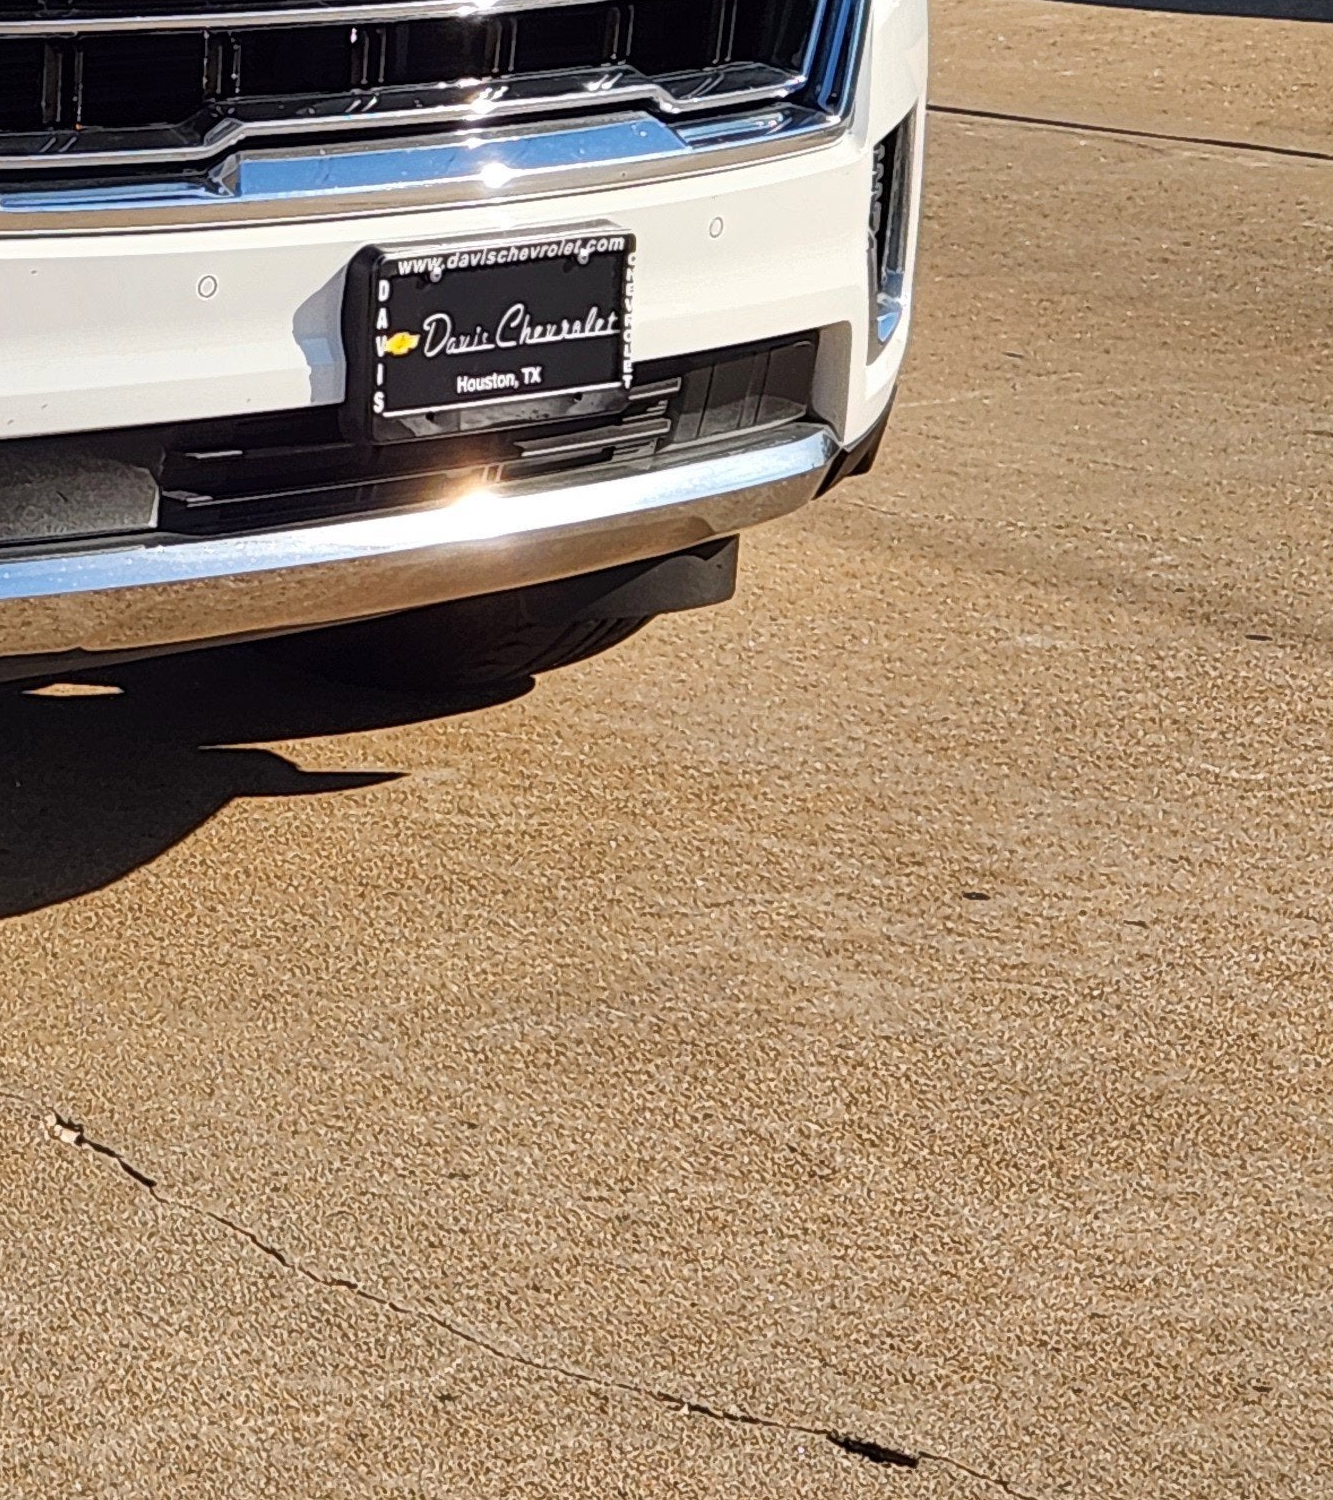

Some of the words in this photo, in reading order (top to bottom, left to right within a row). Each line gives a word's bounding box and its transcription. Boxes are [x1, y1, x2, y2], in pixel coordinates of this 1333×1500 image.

[398, 236, 625, 276] www.davischevrolet.com
[373, 280, 390, 414] DAVIS
[423, 313, 495, 357] Davis
[495, 303, 620, 348] Chevrolet
[457, 373, 519, 394] Houston,
[521, 366, 542, 384] TX
